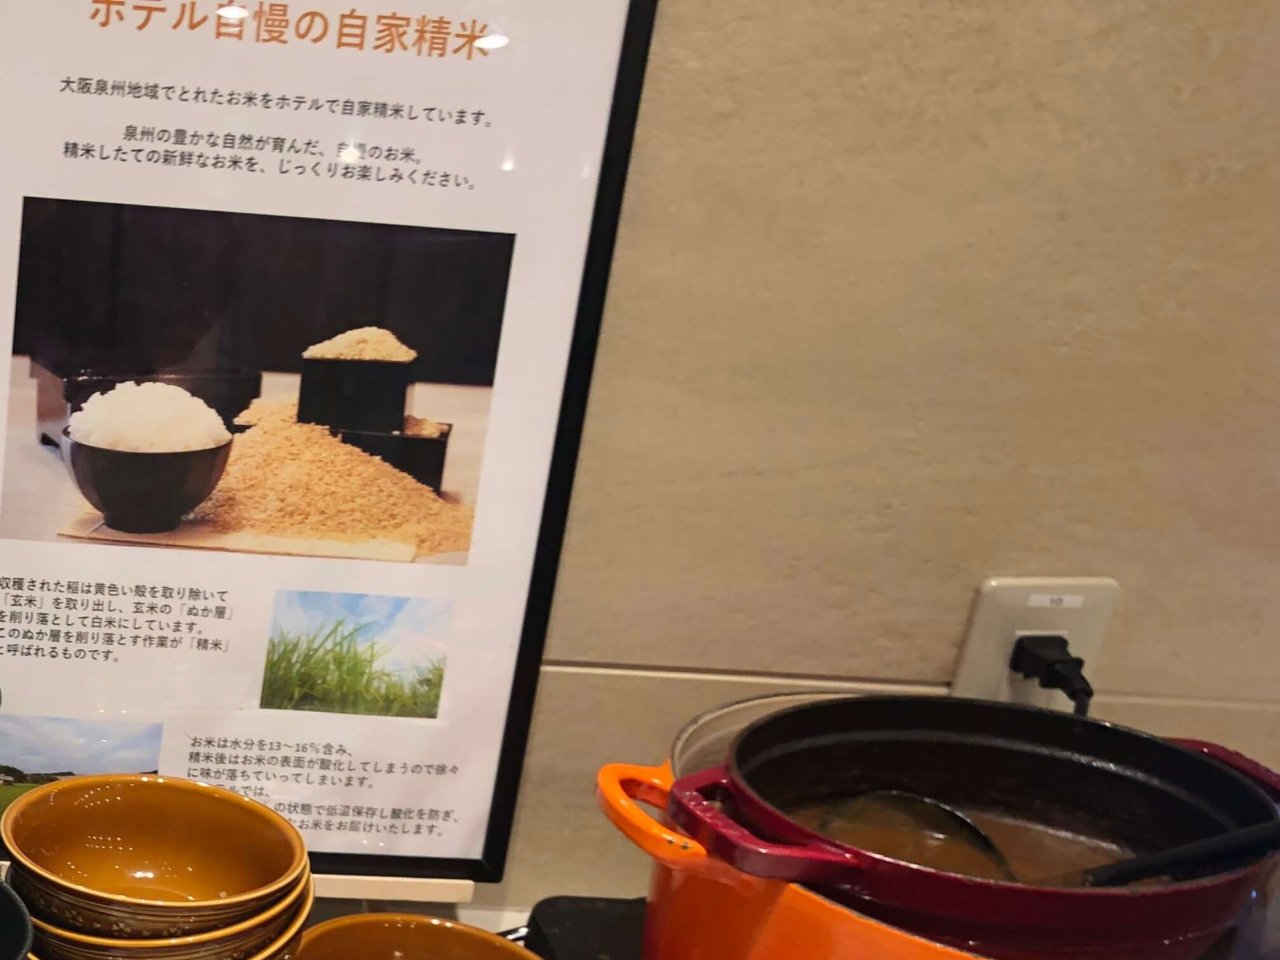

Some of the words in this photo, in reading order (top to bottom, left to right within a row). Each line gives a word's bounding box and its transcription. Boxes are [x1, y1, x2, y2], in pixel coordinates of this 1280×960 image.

[90, 0, 494, 61] ホテル自慢の自家精米
[60, 76, 492, 128] 大阪泉州地域でとれたお米をホテルで自家精米しています。
[63, 140, 475, 190] 精米したての新鮮なお米を、じっくりお楽しみください。
[187, 767, 374, 789] に味が落ちていってしまいます。
